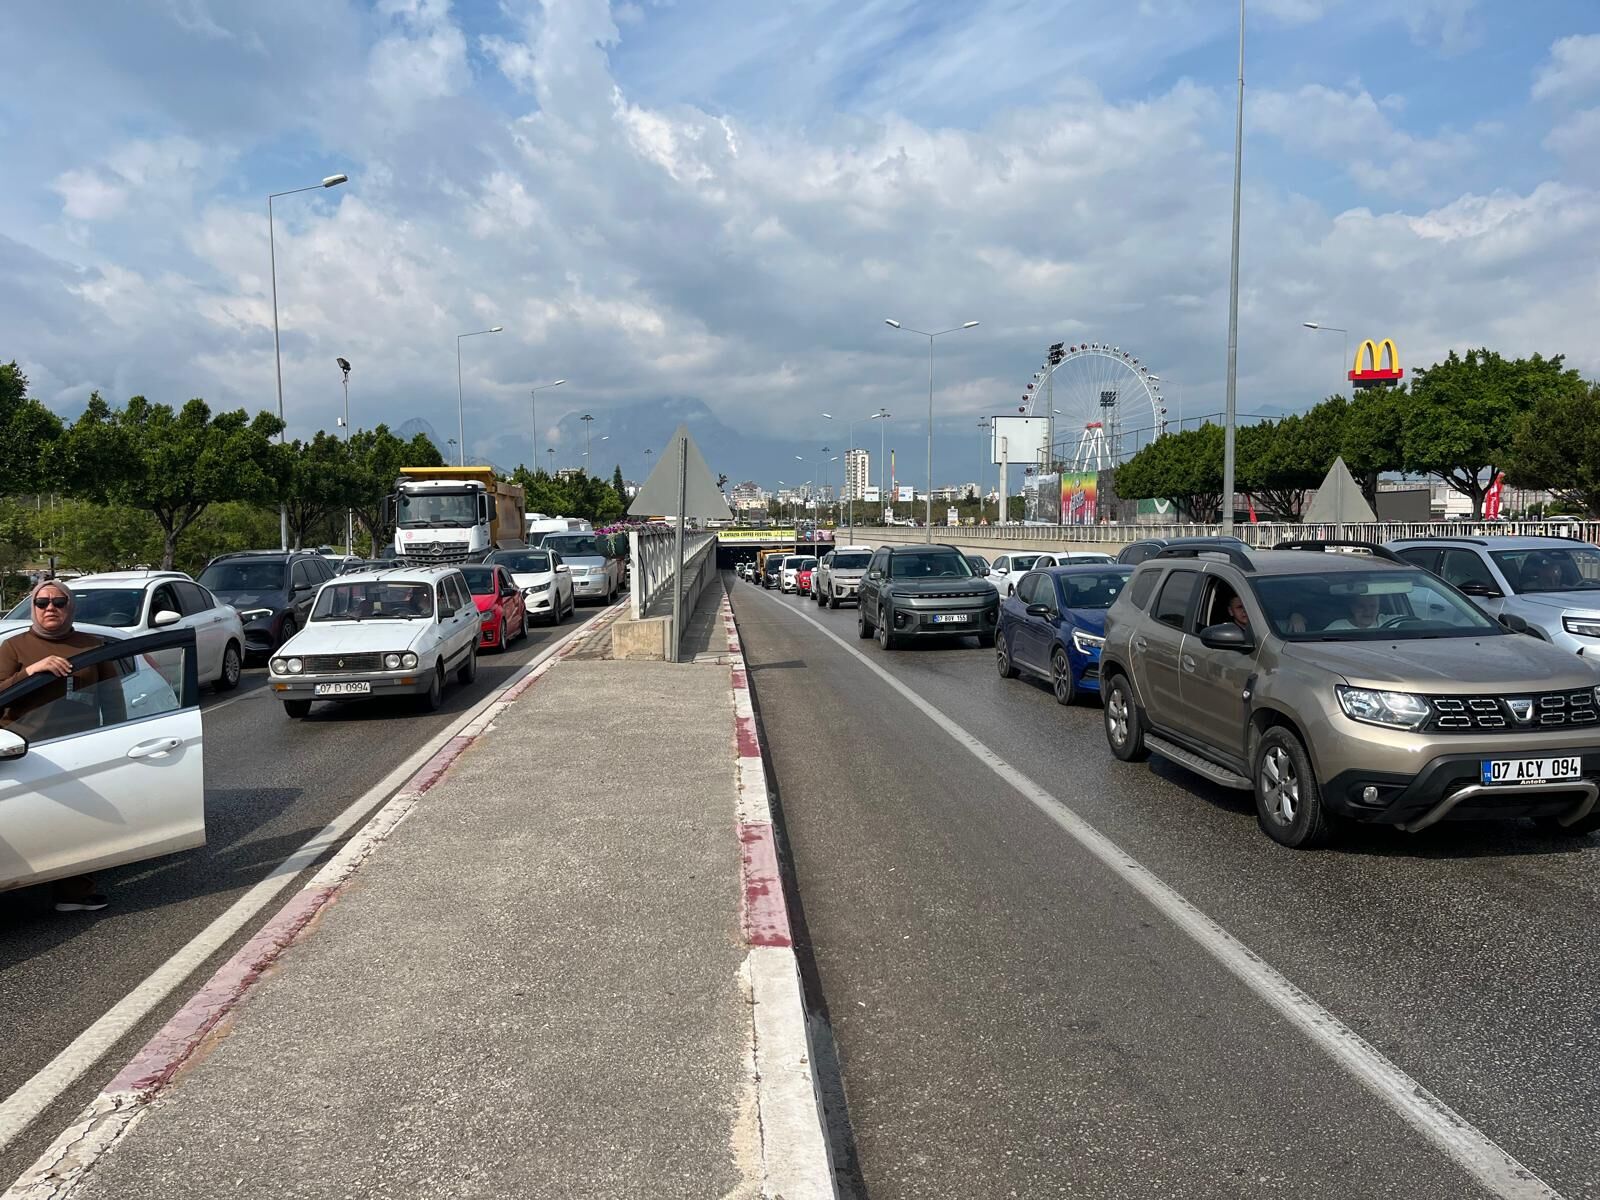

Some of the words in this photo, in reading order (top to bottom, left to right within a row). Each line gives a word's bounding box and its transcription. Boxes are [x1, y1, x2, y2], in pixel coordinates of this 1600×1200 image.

[320, 684, 331, 693] 07
[335, 683, 341, 692] D
[346, 682, 368, 692] 0994
[1492, 762, 1511, 779] 07
[1517, 760, 1544, 778] ACY
[1552, 759, 1578, 776] 094
